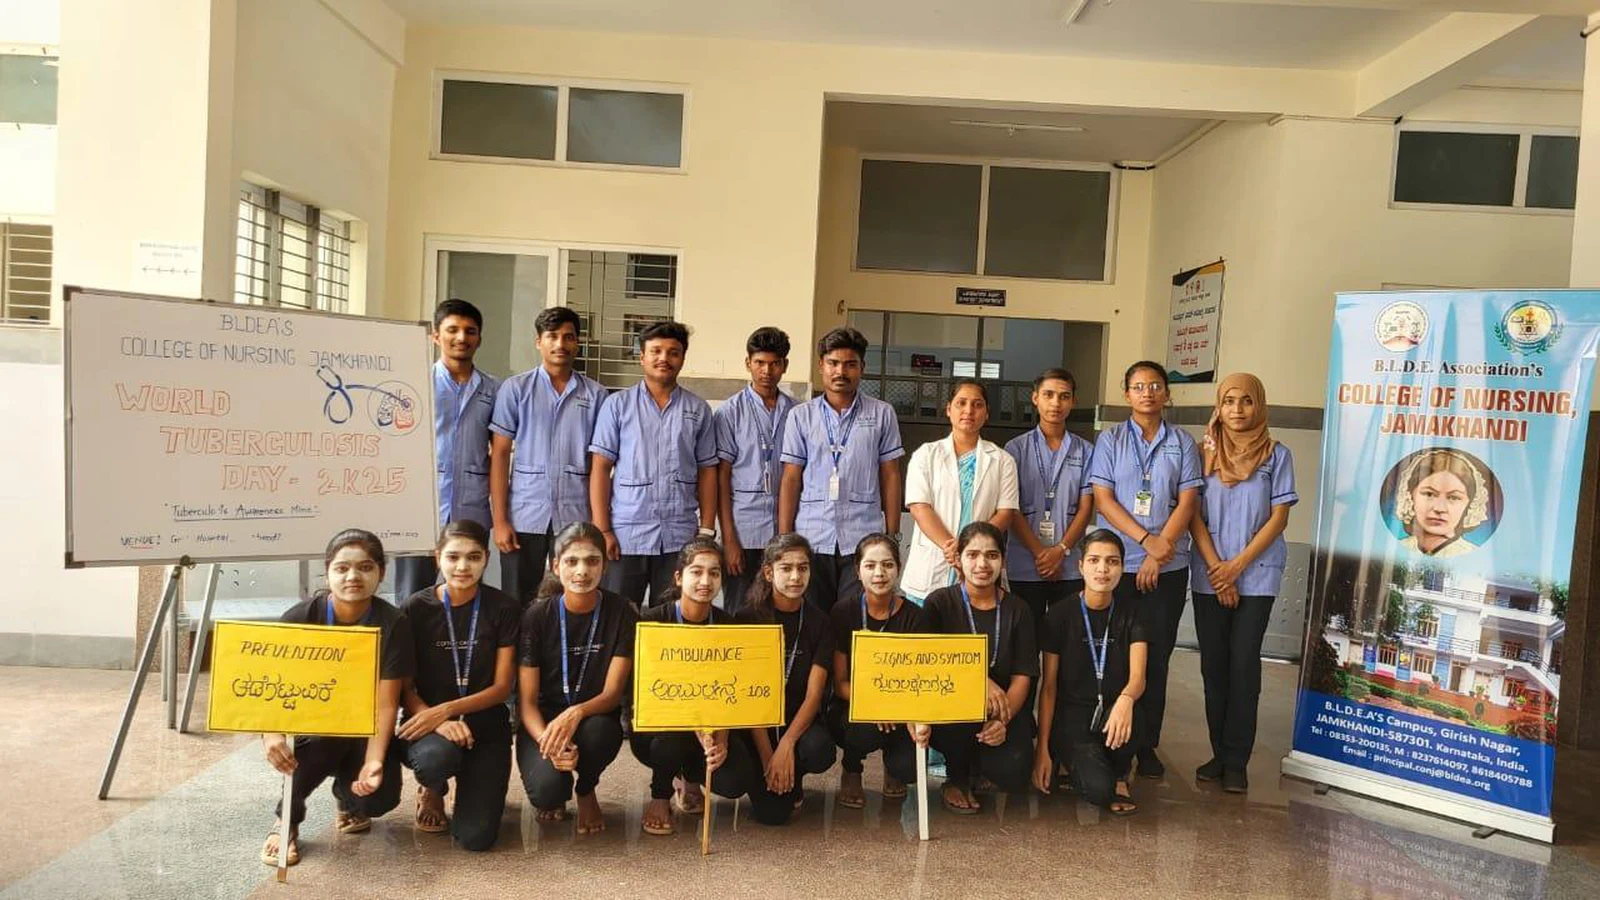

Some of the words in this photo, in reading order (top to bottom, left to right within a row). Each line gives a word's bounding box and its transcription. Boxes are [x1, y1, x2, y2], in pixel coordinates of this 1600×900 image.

[219, 313, 294, 336] BLDEA'S
[120, 336, 193, 360] COLLEGE
[199, 339, 218, 360] OF
[223, 344, 296, 366] NURSING
[309, 350, 395, 372] JAMKHANDI
[1439, 361, 1544, 377] Association's
[115, 383, 231, 416] WORLD
[1338, 383, 1422, 407] COLLEGE
[1430, 386, 1456, 409] OF
[1463, 387, 1577, 419] NURSING,
[160, 425, 381, 458] TUBERCULOSIS
[1380, 412, 1528, 443] JAMAKHANDI
[317, 466, 408, 496] 2K25
[240, 640, 347, 662] PREVENTION
[660, 647, 744, 662] AMBULANCE
[872, 650, 913, 667] SIGNS
[914, 652, 938, 665] AND
[939, 651, 981, 665] SYMTOM
[1342, 745, 1367, 758] Email
[1386, 716, 1437, 737] Campus,
[1440, 728, 1477, 745] Girish
[1480, 737, 1521, 757] Nagar,
[1436, 742, 1494, 765] Karnataka,
[1497, 757, 1529, 773] India.
[1471, 765, 1533, 788] 8618405788
